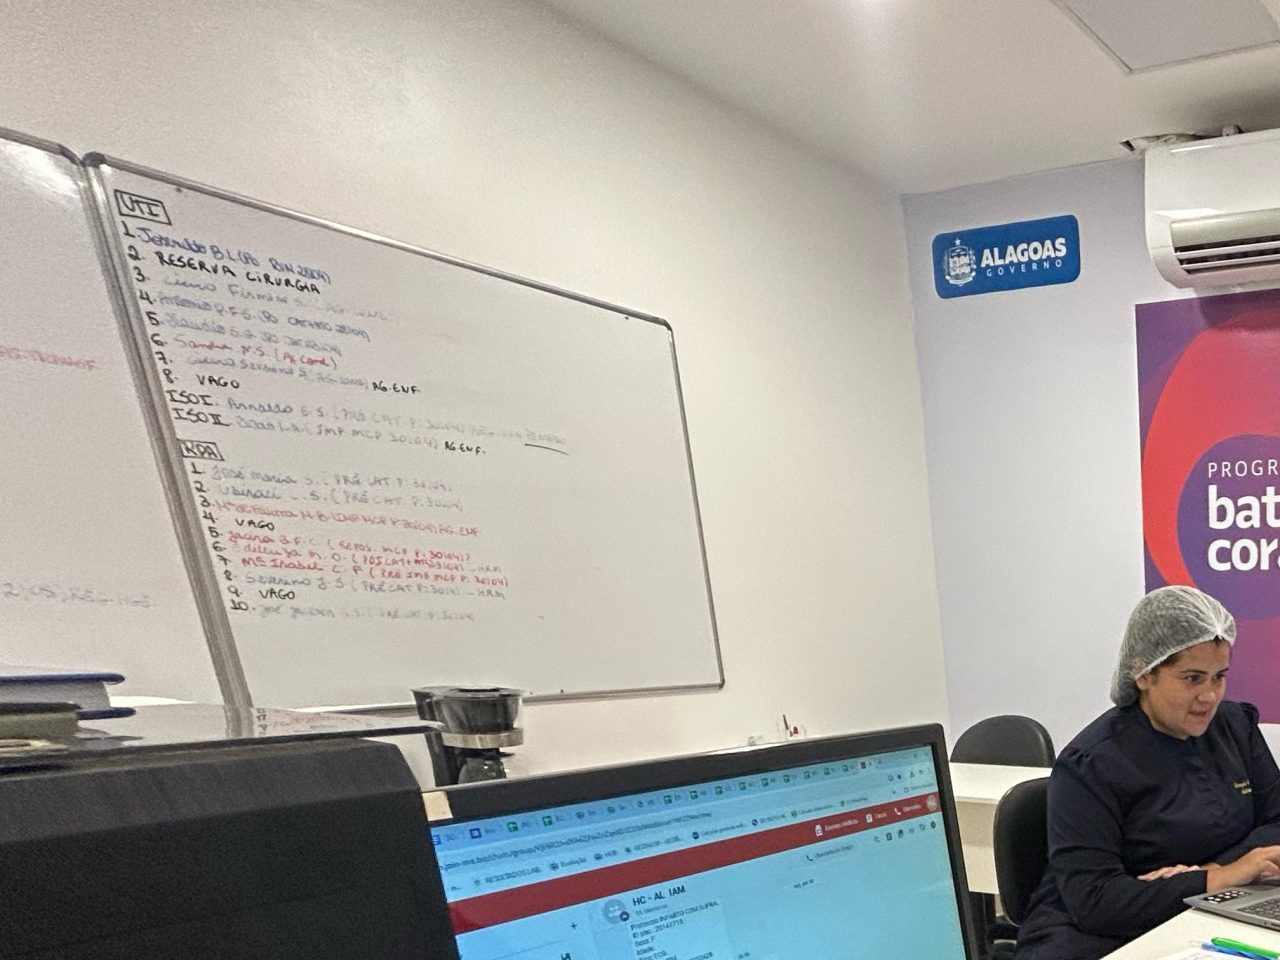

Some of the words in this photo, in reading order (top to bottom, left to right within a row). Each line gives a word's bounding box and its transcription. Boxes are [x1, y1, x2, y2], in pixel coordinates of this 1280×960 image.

[981, 237, 1067, 268] ALAGOAS
[155, 250, 236, 277] RESERVA
[986, 259, 1062, 277] GOVERNO
[197, 374, 241, 390] VAGO
[235, 518, 275, 532] VAGO
[258, 588, 296, 601] VAGO
[632, 895, 647, 907] HC
[654, 890, 665, 902] AL
[669, 885, 686, 897] IAM
